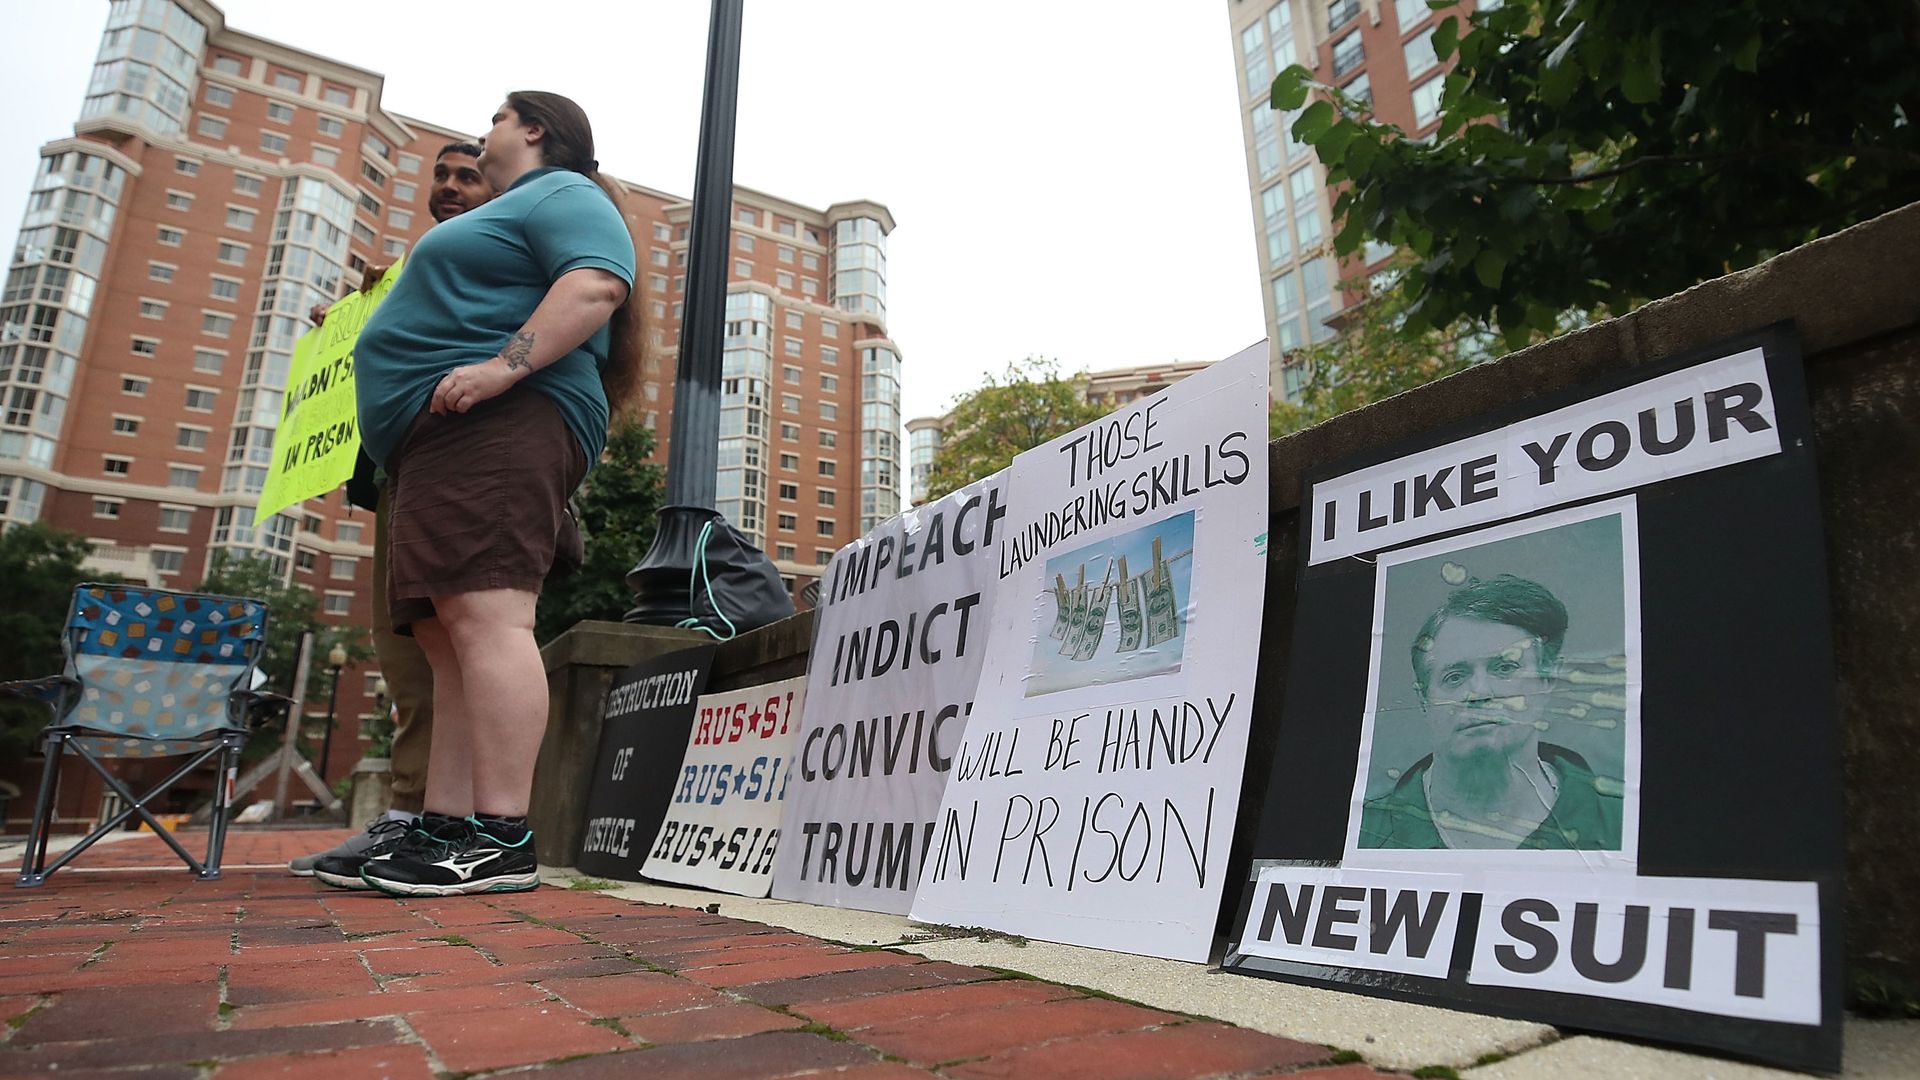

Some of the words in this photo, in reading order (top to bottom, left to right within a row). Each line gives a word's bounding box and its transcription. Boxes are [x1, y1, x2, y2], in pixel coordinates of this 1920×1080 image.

[281, 442, 302, 474] IN
[303, 416, 355, 464] PRISON
[1060, 396, 1168, 488] THOSE
[1323, 500, 1338, 541] I
[1358, 454, 1498, 532] LIKE
[1521, 381, 1772, 486] YOUR
[829, 488, 1007, 606] IMPEACH
[831, 592, 981, 687] INDICT
[612, 747, 633, 781] OF
[801, 702, 974, 783] CONVIC
[957, 727, 1023, 783] WILL
[1044, 713, 1090, 773] BE
[1099, 693, 1236, 774] HANDY
[933, 800, 978, 884] IN
[993, 787, 1214, 892] PRISON
[1257, 882, 1451, 959] NEW
[1494, 898, 1798, 999] SUIT
